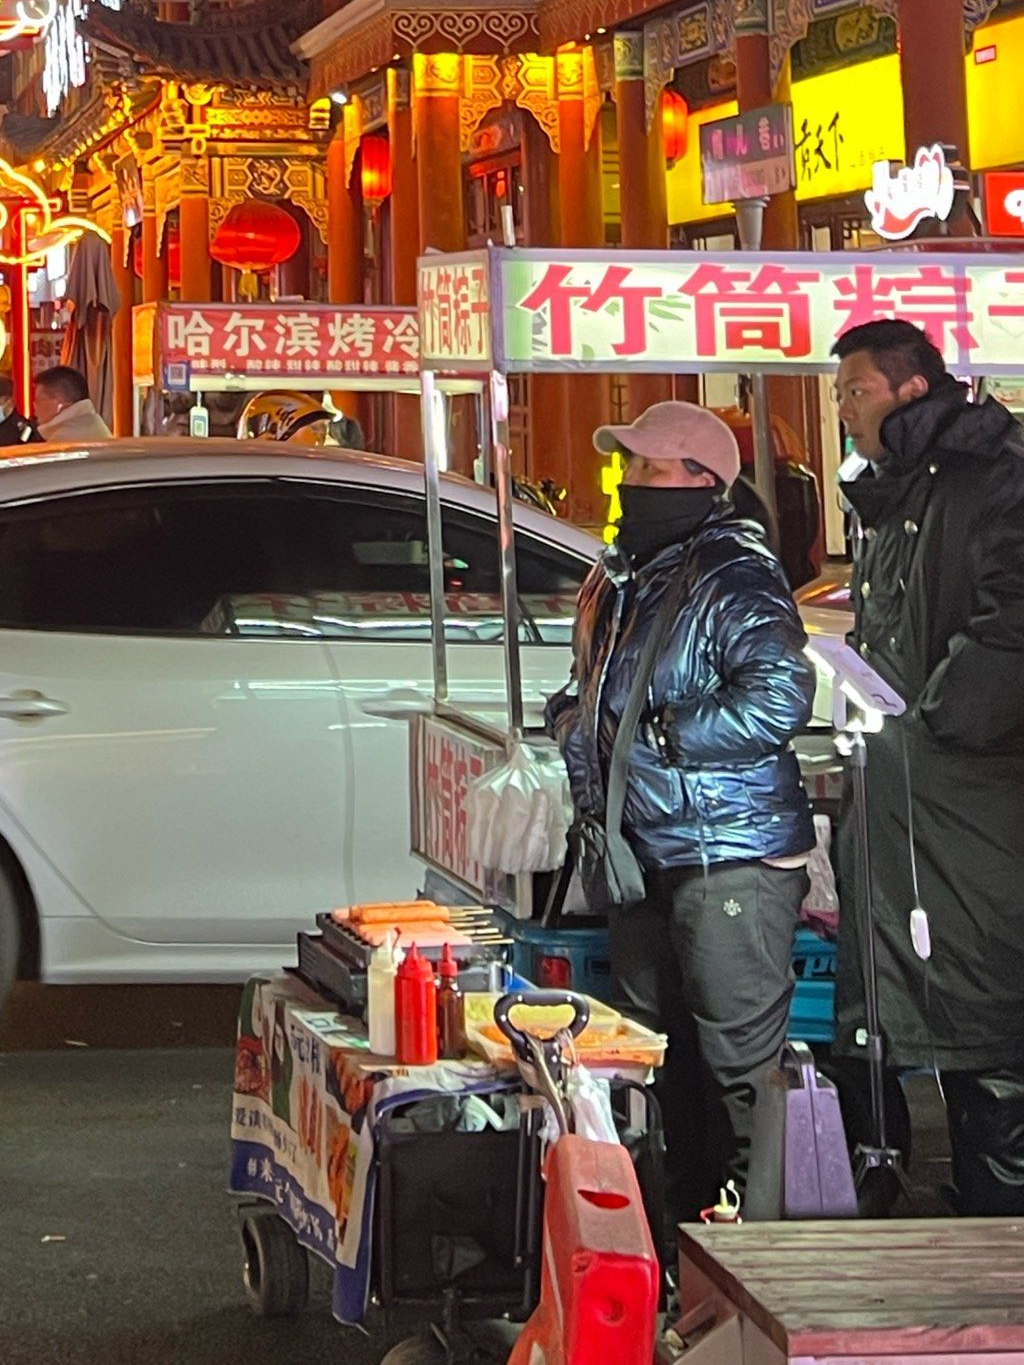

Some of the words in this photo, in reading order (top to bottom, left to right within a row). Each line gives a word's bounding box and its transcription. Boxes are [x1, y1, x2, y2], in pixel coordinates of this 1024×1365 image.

[422, 267, 489, 356] 竹筒粽子
[521, 263, 1024, 358] 竹筒粽
